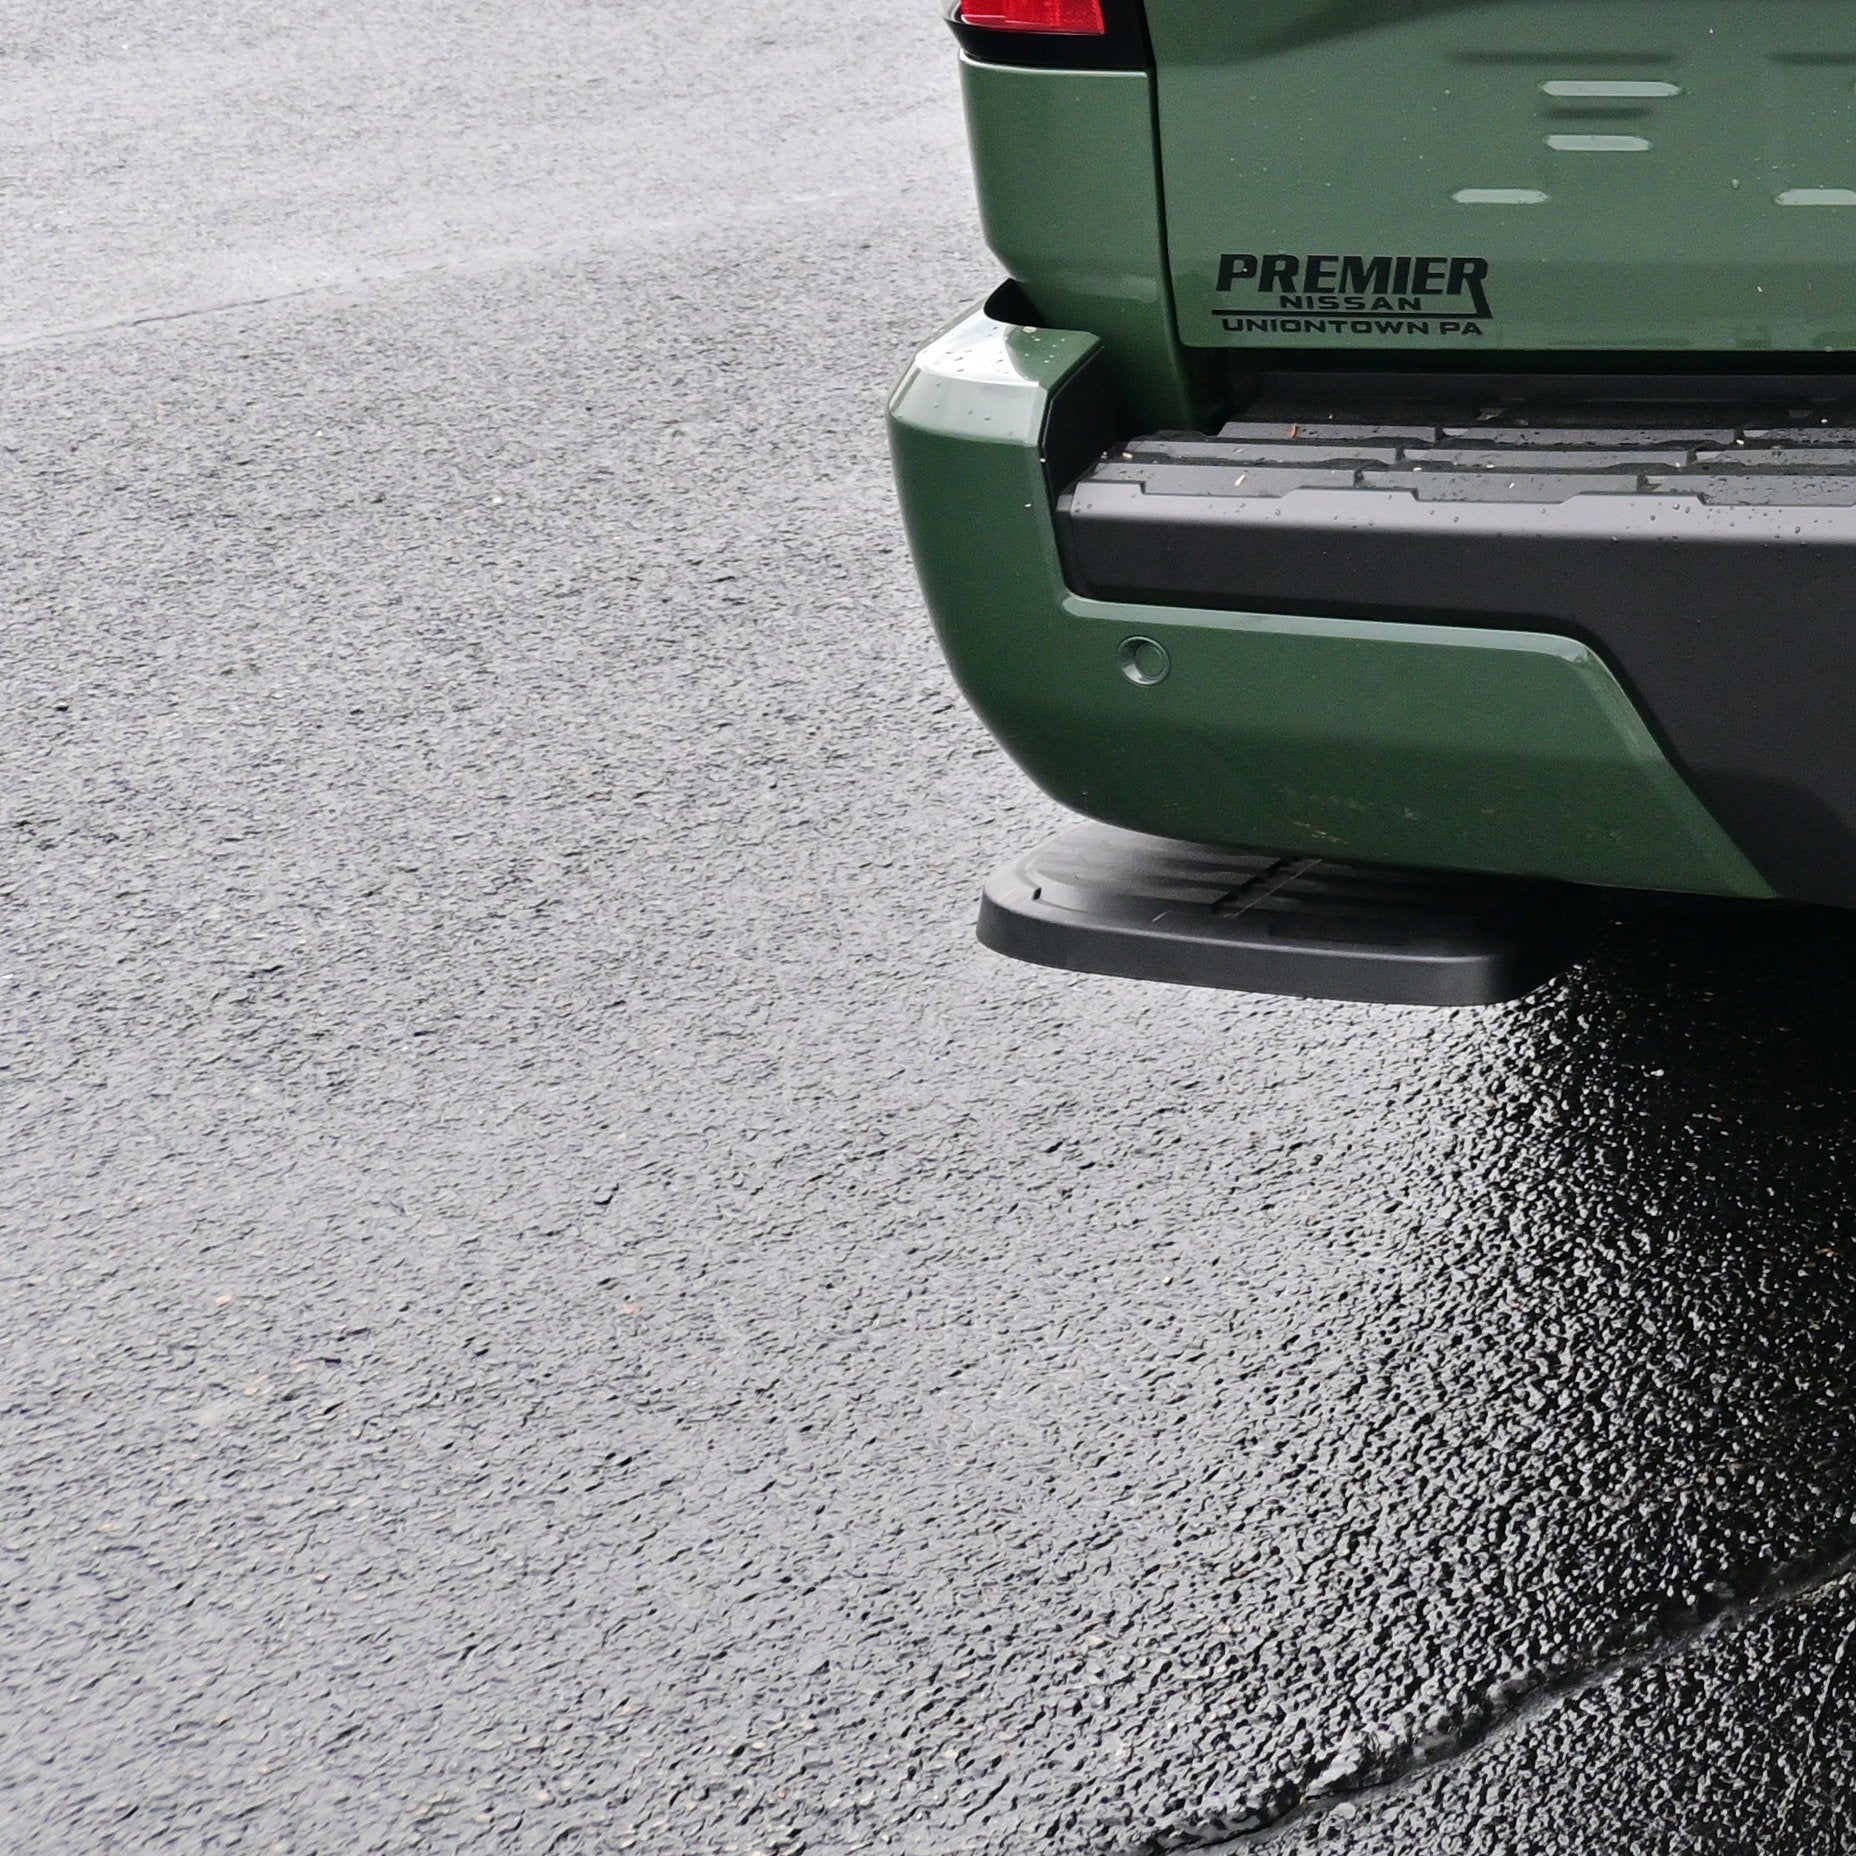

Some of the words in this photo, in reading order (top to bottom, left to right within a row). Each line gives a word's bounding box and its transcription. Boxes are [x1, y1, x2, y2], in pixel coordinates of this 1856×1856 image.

[1215, 253, 1490, 296] PREMIER
[1280, 294, 1422, 311] NISSAN
[1221, 318, 1430, 335] UNIONTOWN
[1439, 320, 1483, 336] PA
